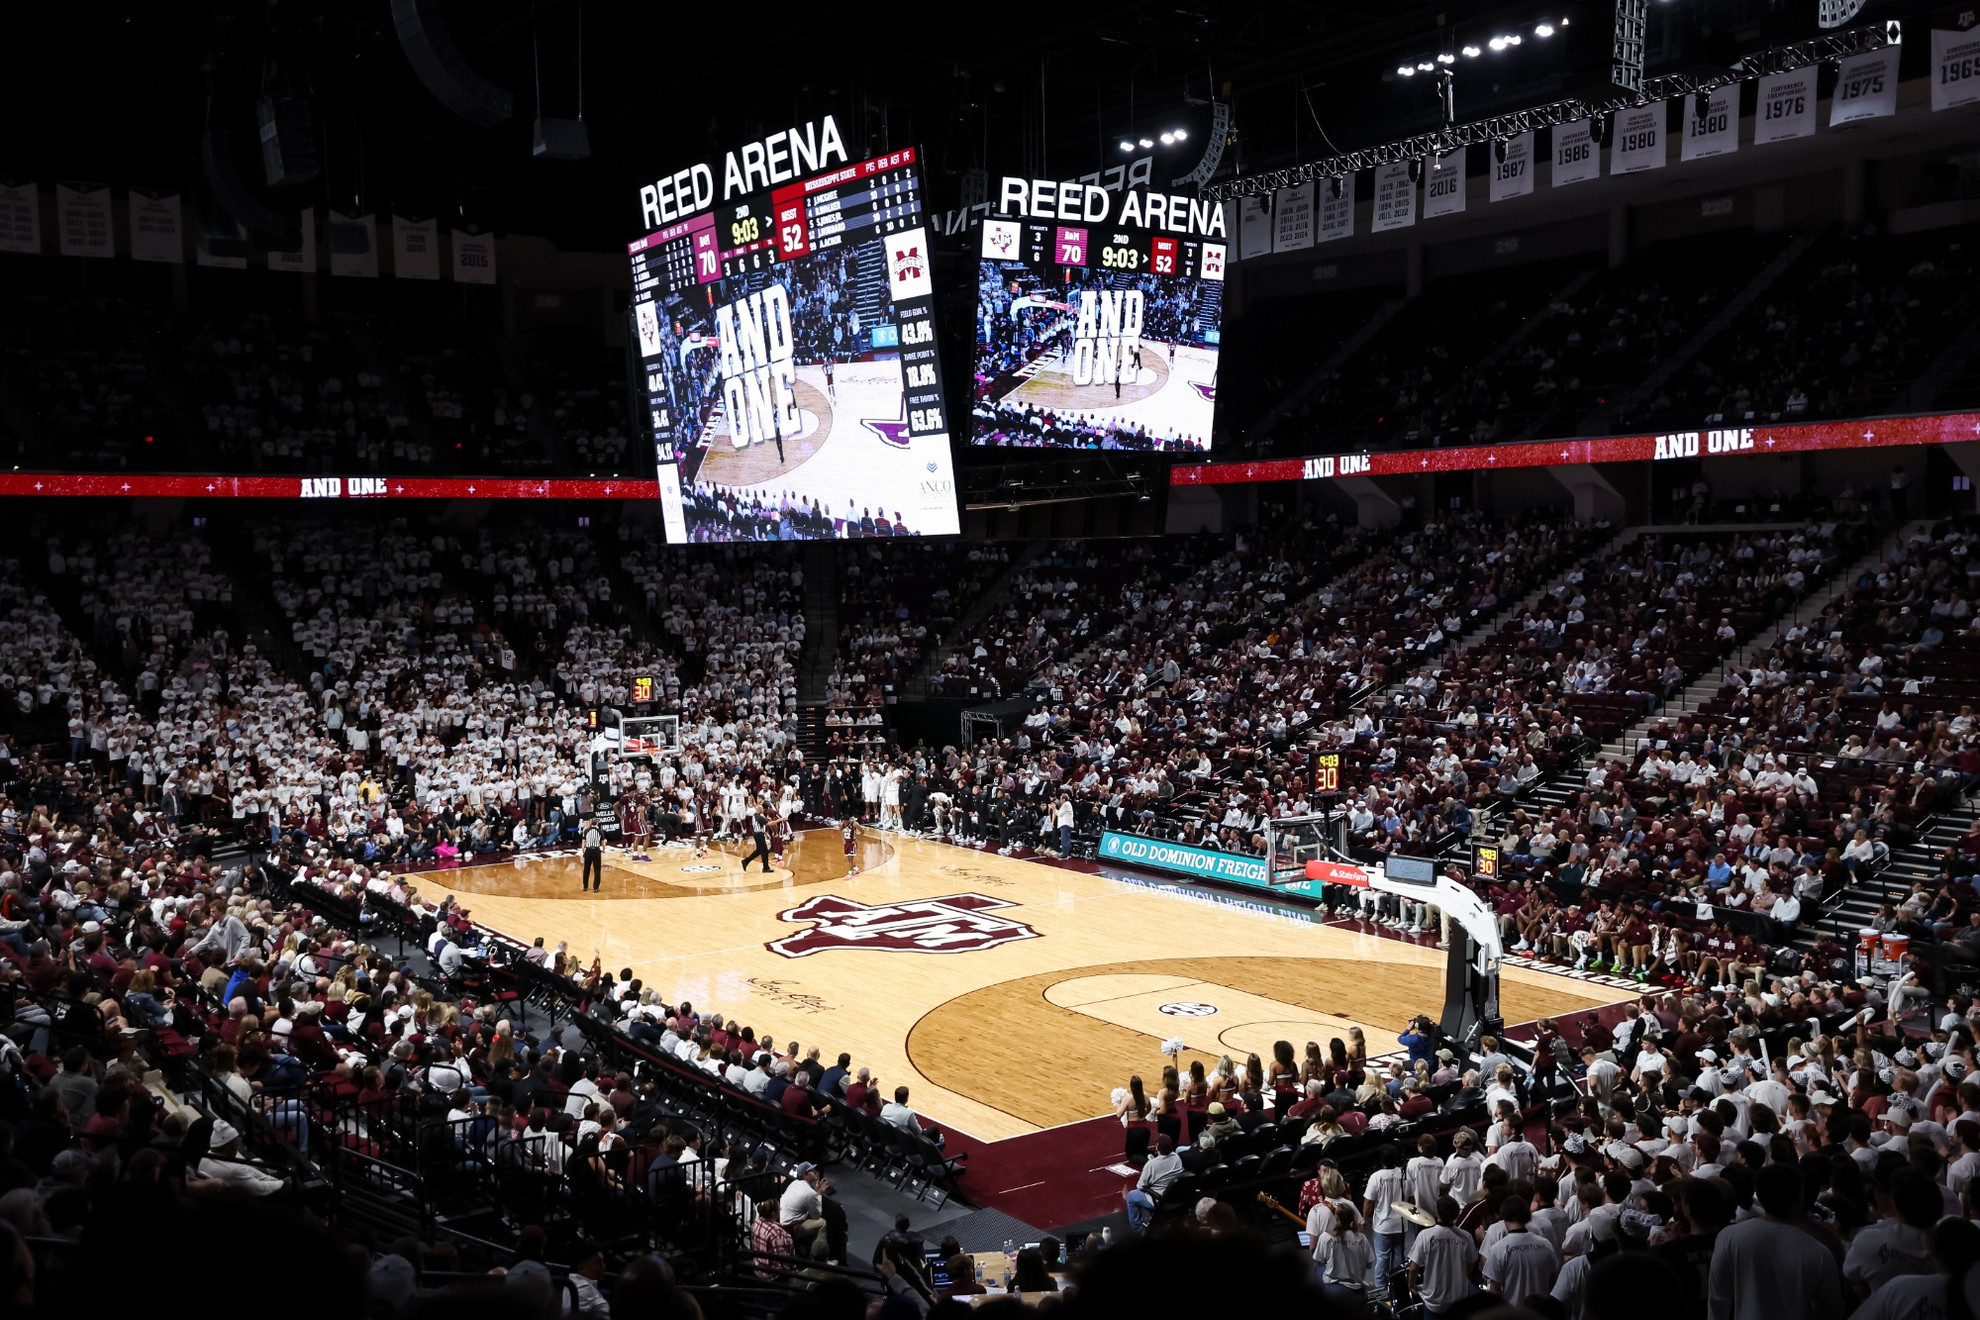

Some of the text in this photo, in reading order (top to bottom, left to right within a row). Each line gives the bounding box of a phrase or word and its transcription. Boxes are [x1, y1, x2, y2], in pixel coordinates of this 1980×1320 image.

[1841, 74, 1885, 100] 1975
[1765, 95, 1805, 121] 1976
[1691, 114, 1727, 138] 1980
[1621, 130, 1656, 152] 1980
[1558, 143, 1590, 166] 1986
[640, 114, 848, 230] REED ARENA
[840, 167, 857, 181] STATE
[865, 162, 876, 173] PTS
[890, 154, 900, 165] AST
[902, 151, 911, 162] FF
[1497, 160, 1526, 181] 1987
[869, 179, 875, 188] 2
[882, 175, 887, 185] 0
[906, 168, 911, 178] 2
[870, 190, 878, 200] 10
[895, 184, 900, 193] 0
[907, 180, 912, 190] 2
[1430, 178, 1457, 198] 2016
[872, 201, 878, 211] 0
[885, 198, 890, 208] 0
[896, 195, 901, 204] 0
[908, 192, 914, 201] 2
[1000, 176, 1110, 223] REED
[1119, 189, 1227, 238] ARENA
[1701, 198, 1733, 217] 220
[735, 204, 750, 220] 2ND
[872, 212, 881, 222] 10
[886, 209, 891, 219] 2
[898, 206, 903, 216] 2
[731, 216, 759, 245] 9:03
[875, 225, 881, 234] 6
[886, 222, 894, 231] 10
[899, 219, 905, 228] 0
[685, 237, 690, 245] 2
[782, 223, 804, 253] 52
[1034, 232, 1041, 242] 3
[1113, 234, 1129, 245] 2ND
[460, 253, 489, 268] 2015
[699, 249, 717, 276] 70
[753, 254, 760, 269] 6
[768, 250, 775, 265] 3
[1033, 253, 1040, 262] 6
[1062, 244, 1081, 263] 70
[1102, 246, 1139, 270] 9:03
[1187, 248, 1193, 258] 3
[724, 261, 731, 277] 3
[739, 258, 746, 273] 6
[1155, 255, 1172, 273] 52
[1186, 267, 1191, 277] 6
[1076, 289, 1144, 339] AND
[716, 282, 794, 380] AND
[1072, 339, 1140, 387] ONE
[723, 358, 802, 449] ONE
[909, 395, 920, 404] FREE
[910, 407, 943, 432] 63.6%
[1654, 426, 1755, 461] AND ONE
[1303, 453, 1371, 480] AND ONE
[300, 478, 388, 498] AND ONE
[920, 479, 951, 495] ANCO
[504, 650, 512, 660] 12
[635, 677, 652, 686] 9:03
[634, 686, 651, 700] 30
[1320, 754, 1340, 767] 9:03
[1317, 767, 1338, 792] 30
[1122, 841, 1267, 881] OLD DOMINION FREIGH
[1480, 848, 1497, 860] 9:03
[1480, 859, 1493, 874] 30
